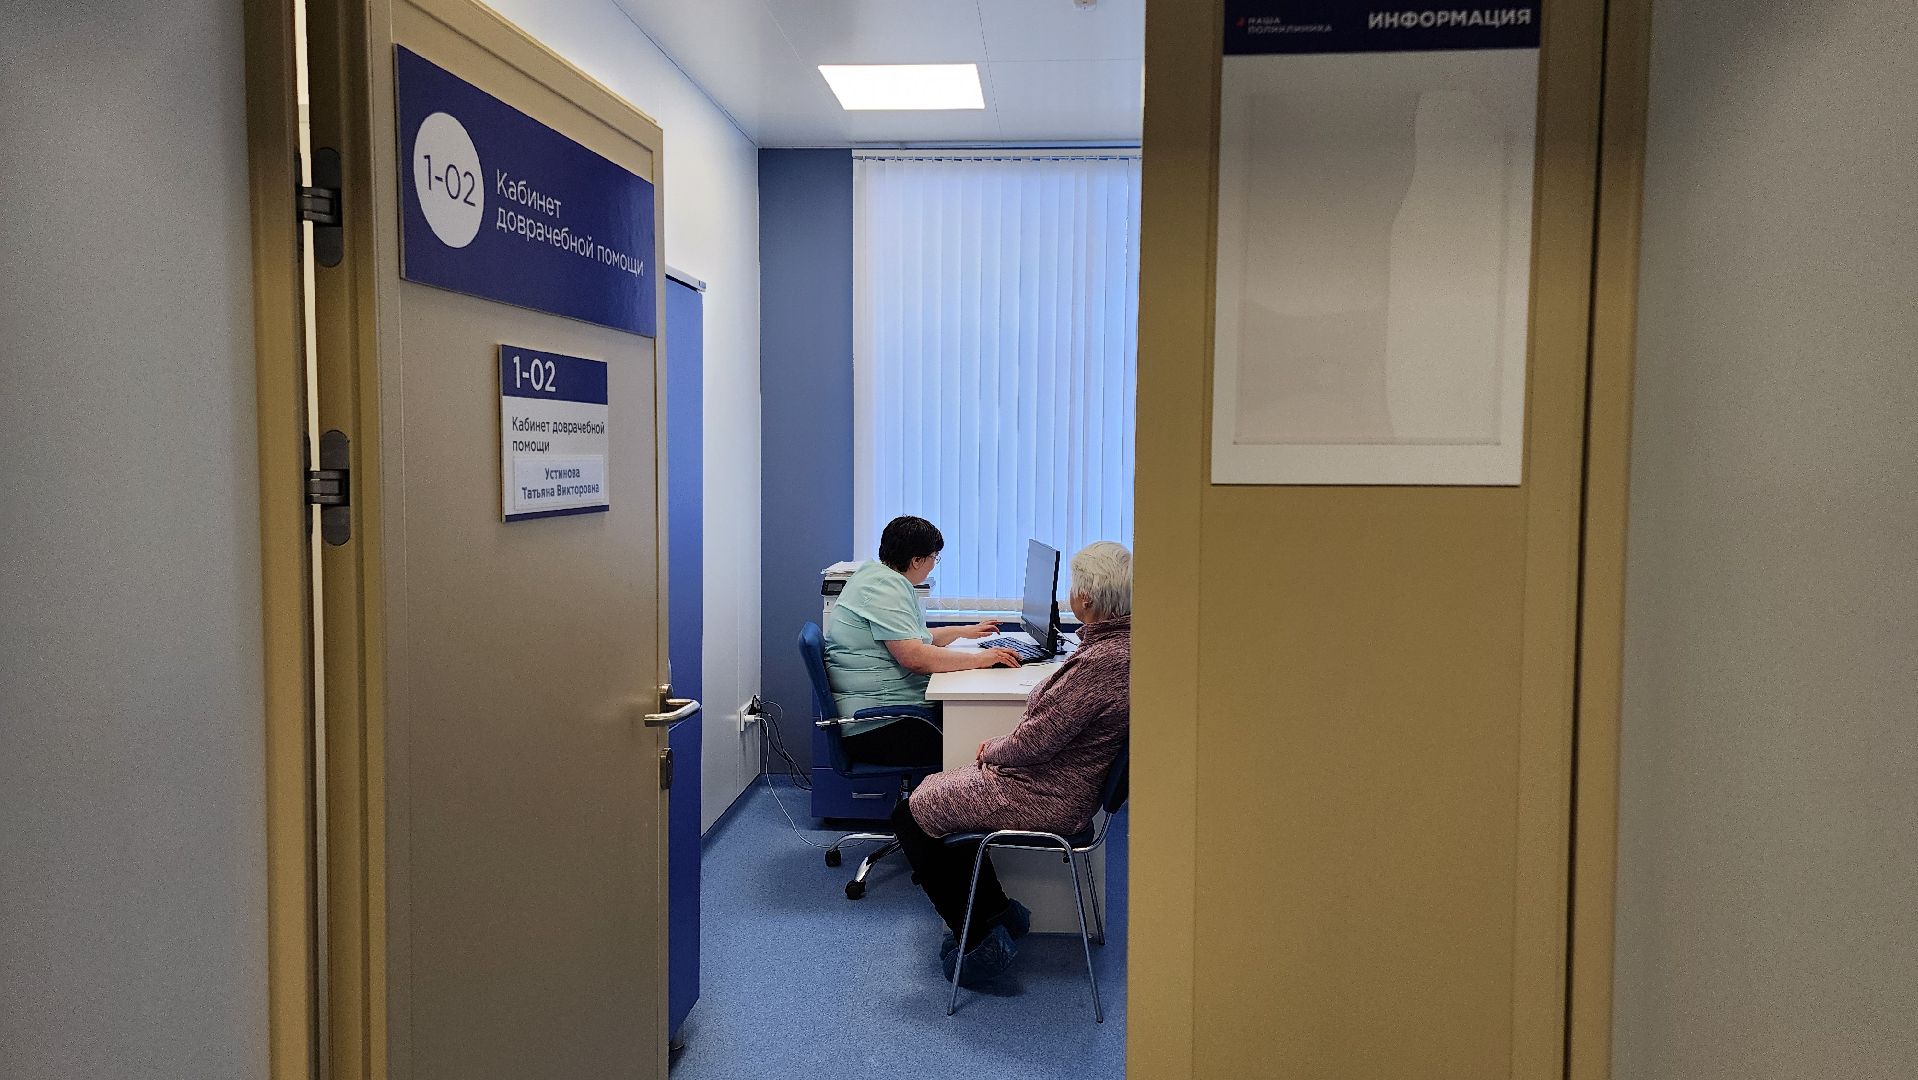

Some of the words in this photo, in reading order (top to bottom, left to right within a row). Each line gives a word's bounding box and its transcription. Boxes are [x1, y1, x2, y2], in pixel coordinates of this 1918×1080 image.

[1247, 16, 1281, 24] НАША
[1368, 9, 1532, 29] ИНФОРМАЦИЯ
[1247, 24, 1333, 34] ПОЛИКЛИНИКА
[423, 154, 476, 208] 1-02
[496, 169, 562, 219] Кабинет
[496, 206, 594, 259] доврачебной
[597, 244, 644, 277] помощи
[513, 355, 556, 392] 1-02
[512, 416, 550, 433] Кабинет
[552, 420, 605, 435] доврачебной
[512, 440, 550, 454] помощи
[544, 467, 580, 480] Устинова
[521, 487, 555, 500] Татьяна
[557, 483, 600, 497] Викторовна
